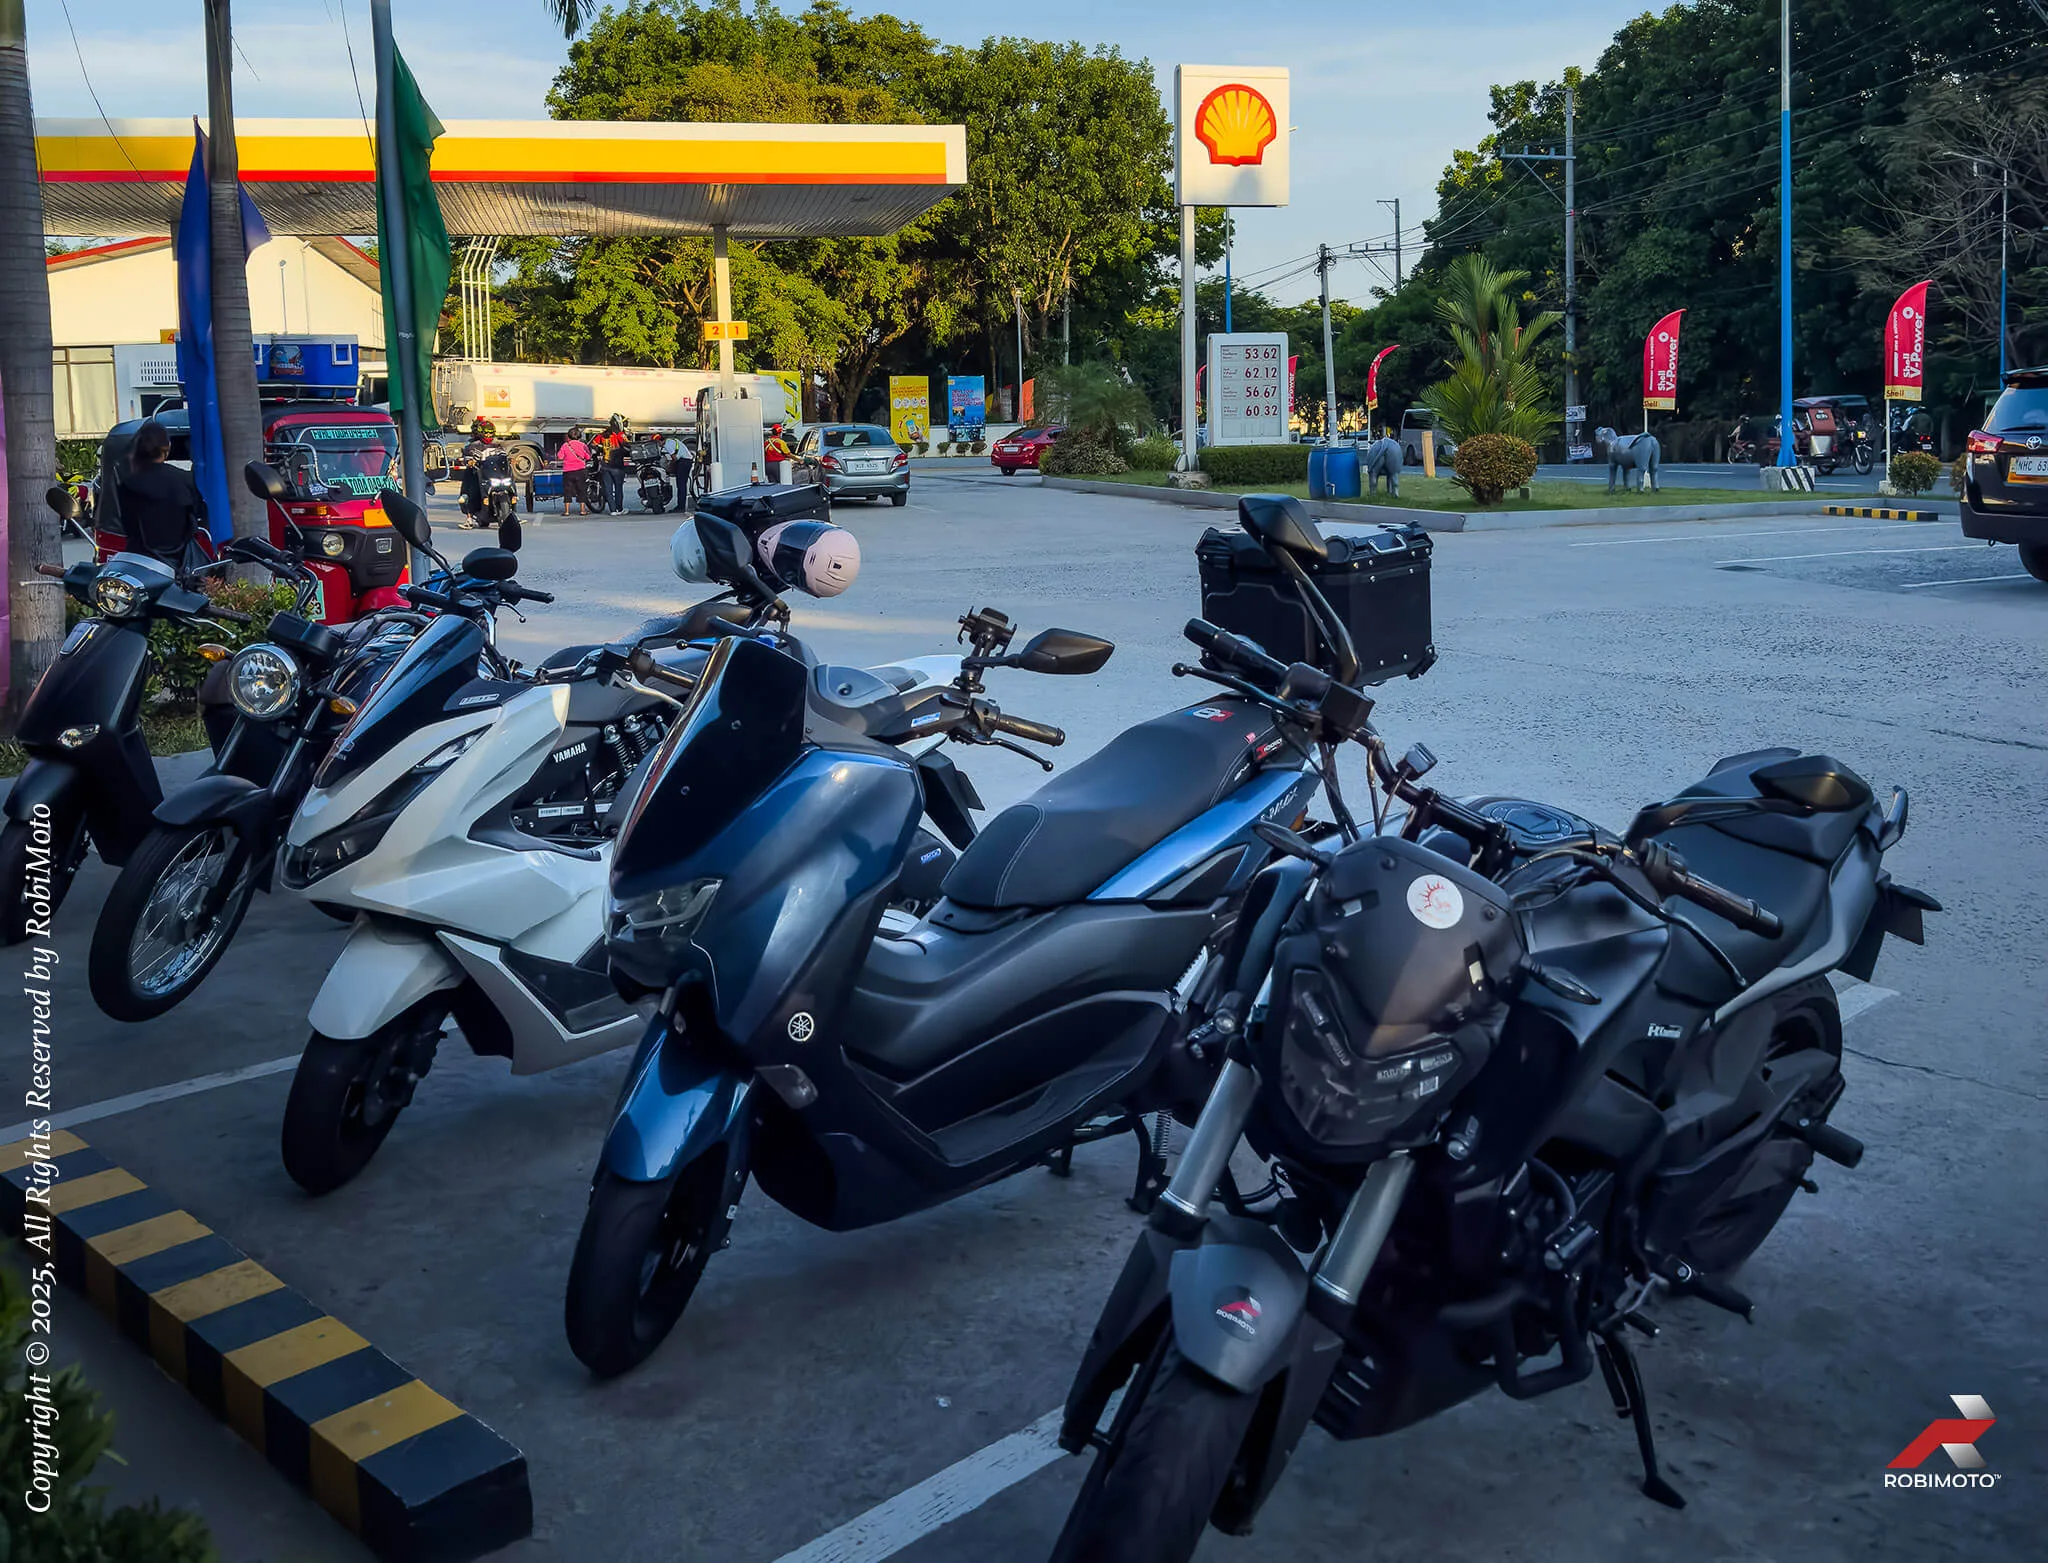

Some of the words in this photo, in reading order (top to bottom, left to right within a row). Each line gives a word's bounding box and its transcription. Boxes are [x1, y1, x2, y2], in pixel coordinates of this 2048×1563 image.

[712, 326, 720, 335] 2
[735, 326, 739, 335] 1
[1910, 312, 1923, 378] V-Power
[1666, 337, 1678, 391] V-Power
[1902, 353, 1910, 378] Shell
[1658, 370, 1666, 391] Shell
[1885, 388, 1905, 398] Shell
[1644, 400, 1658, 408] Shell
[2036, 460, 2048, 472] 63
[349, 478, 368, 494] TODA
[552, 742, 588, 764] YAMAHA
